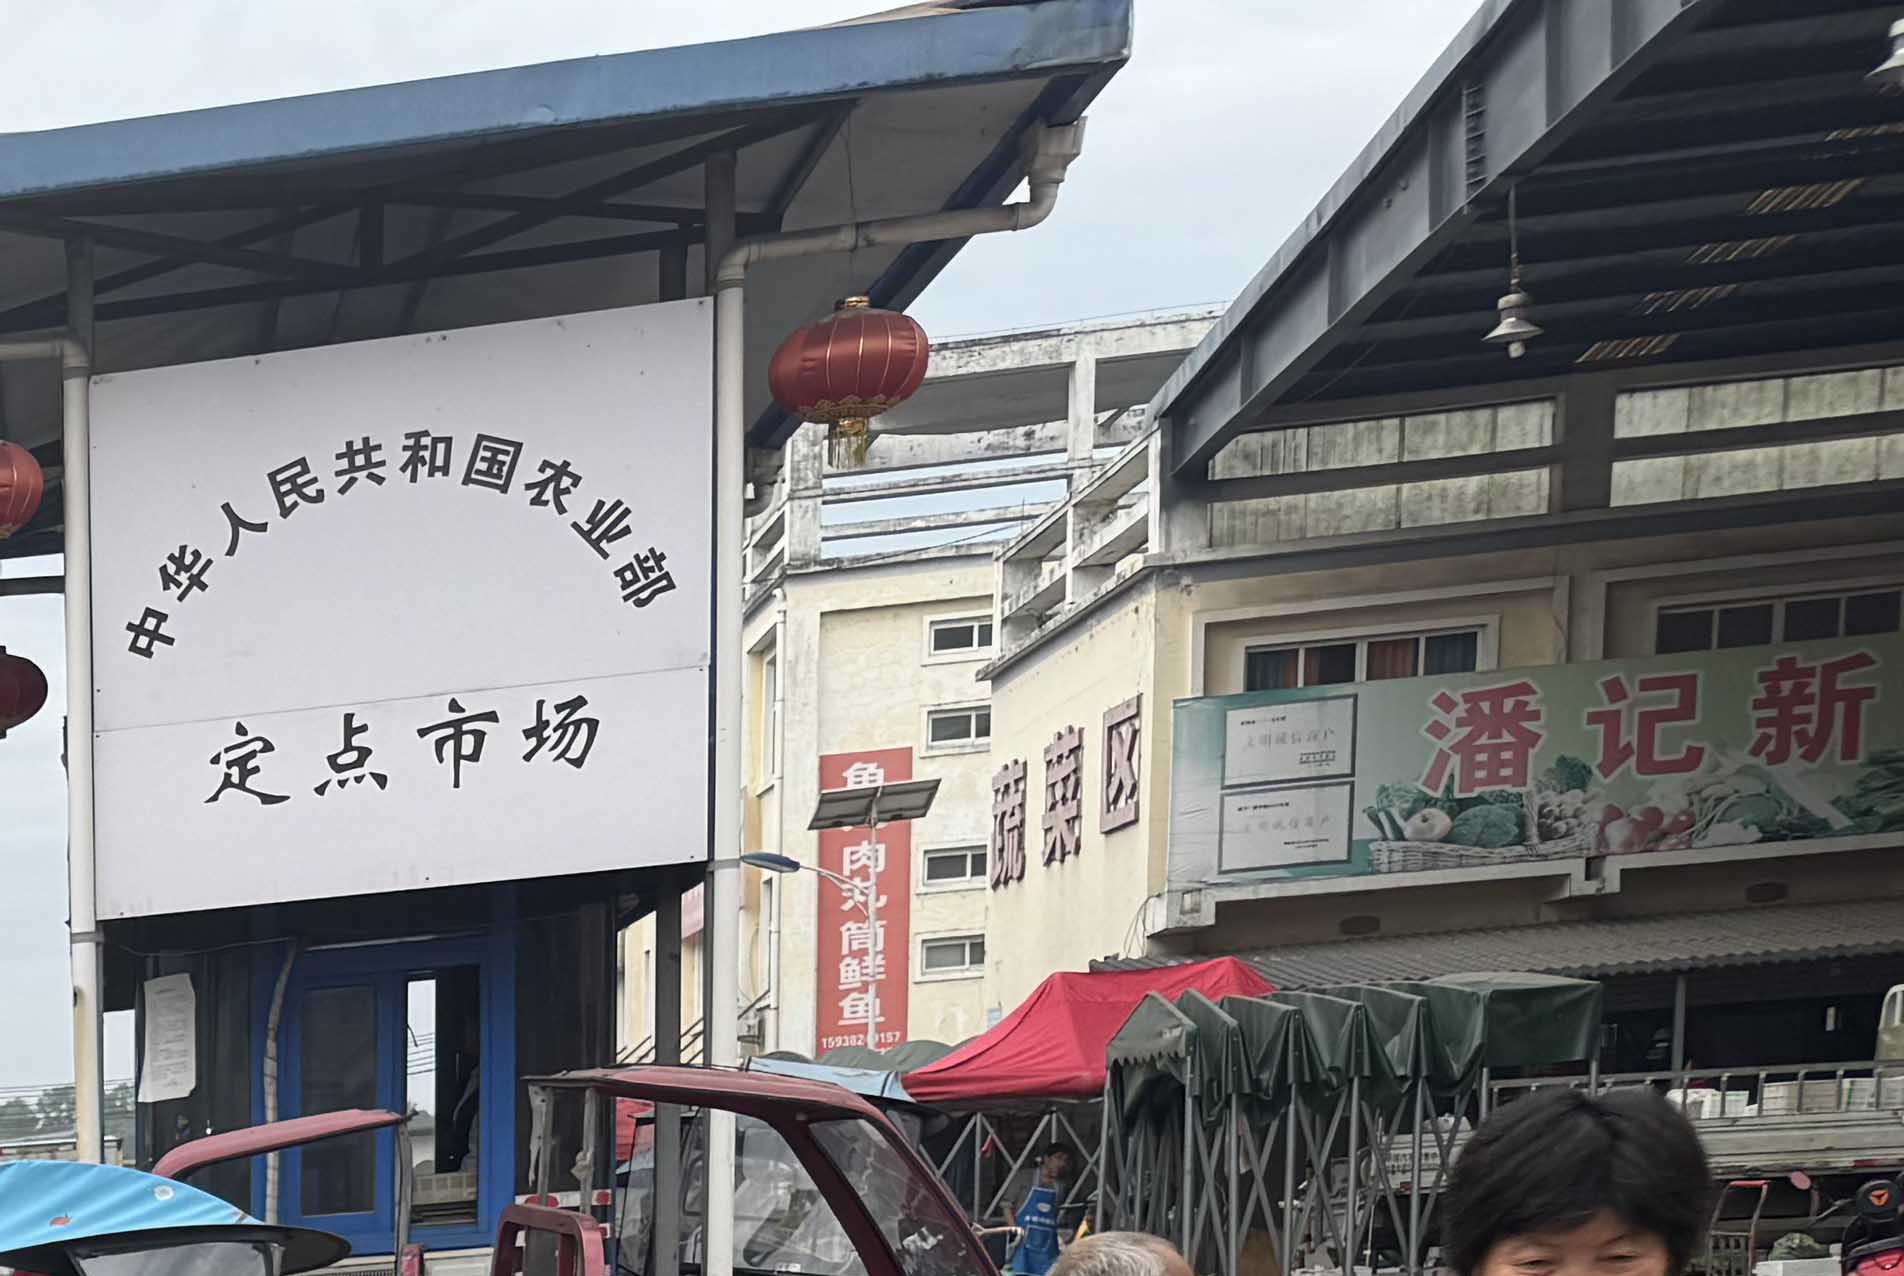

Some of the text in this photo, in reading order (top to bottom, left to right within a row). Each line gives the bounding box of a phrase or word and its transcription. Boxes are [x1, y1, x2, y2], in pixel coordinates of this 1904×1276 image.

[125, 427, 679, 660] 中华人民共和国农业部
[205, 692, 601, 804] 定点市场
[992, 694, 1142, 891] 蔬菜区
[1421, 652, 1879, 799] 潘记新
